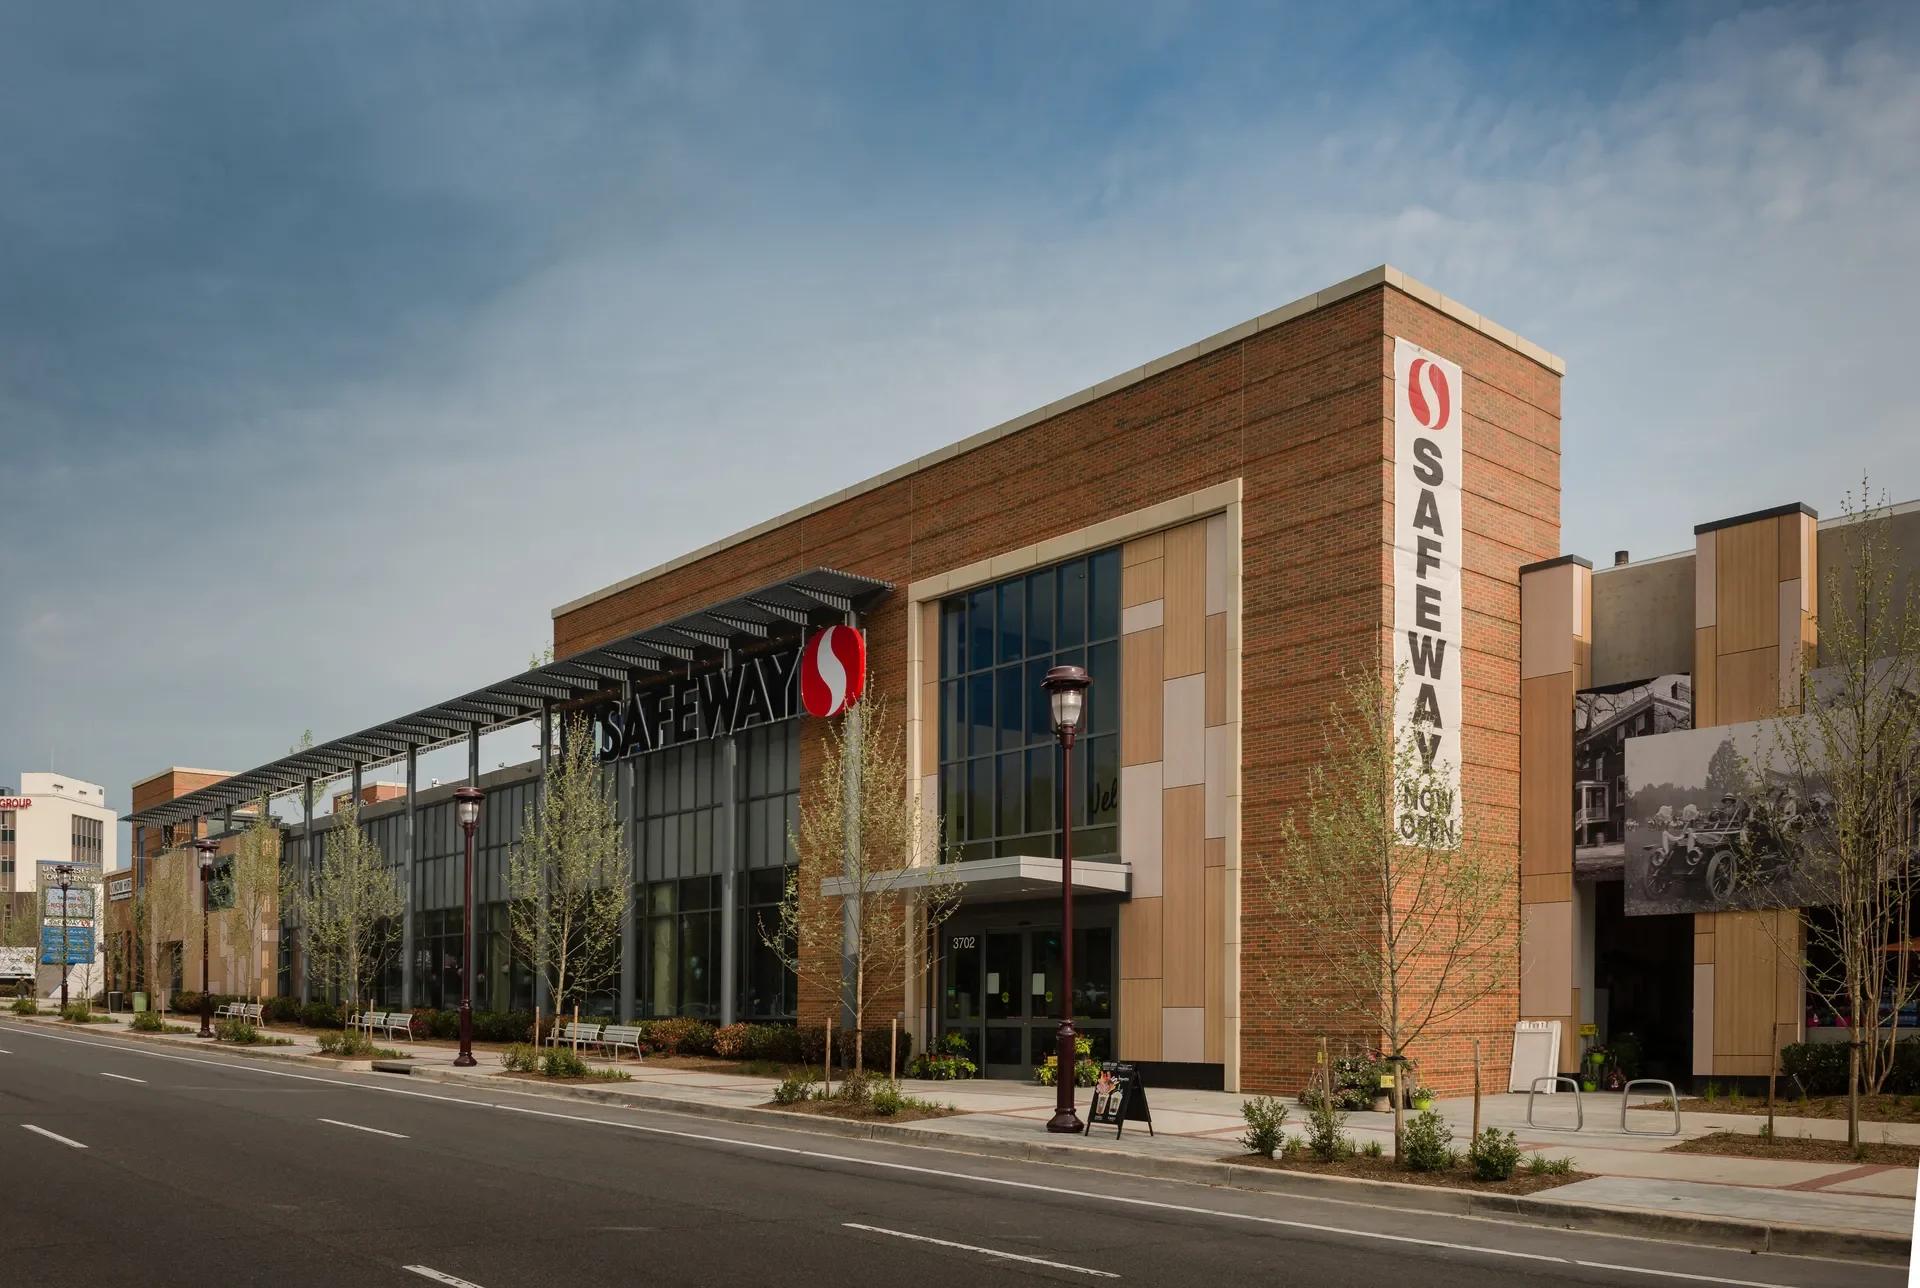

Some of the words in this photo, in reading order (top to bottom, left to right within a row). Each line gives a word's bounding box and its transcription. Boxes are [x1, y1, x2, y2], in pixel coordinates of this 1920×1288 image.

[1408, 436, 1448, 774] SAFEWAY
[599, 646, 804, 763] SAFEWAY
[0, 798, 32, 809] GROUP
[42, 865, 94, 875] UNRSITY
[47, 918, 81, 926] SAFWAY
[953, 936, 975, 949] 3702
